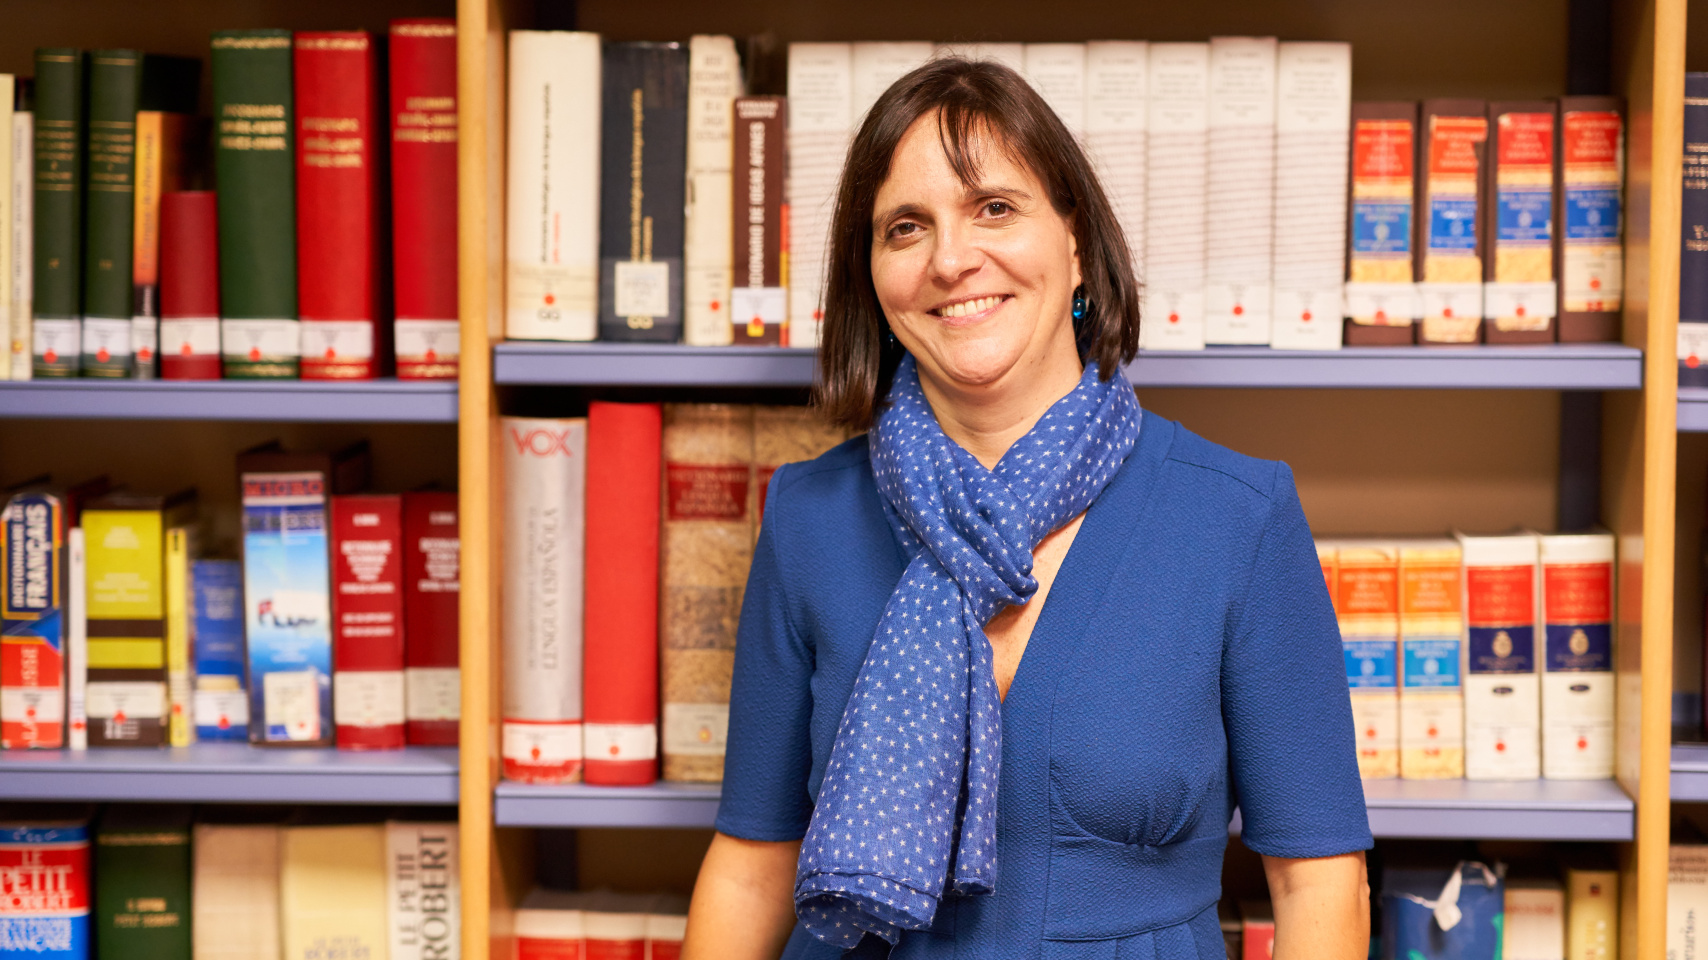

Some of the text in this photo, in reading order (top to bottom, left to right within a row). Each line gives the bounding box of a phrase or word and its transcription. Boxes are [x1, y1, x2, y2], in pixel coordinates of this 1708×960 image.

[510, 427, 573, 457] VOX
[26, 504, 52, 608] FRANÇAIS
[537, 507, 558, 670] LENGUA ESPAÑOLA
[399, 925, 417, 945] LE
